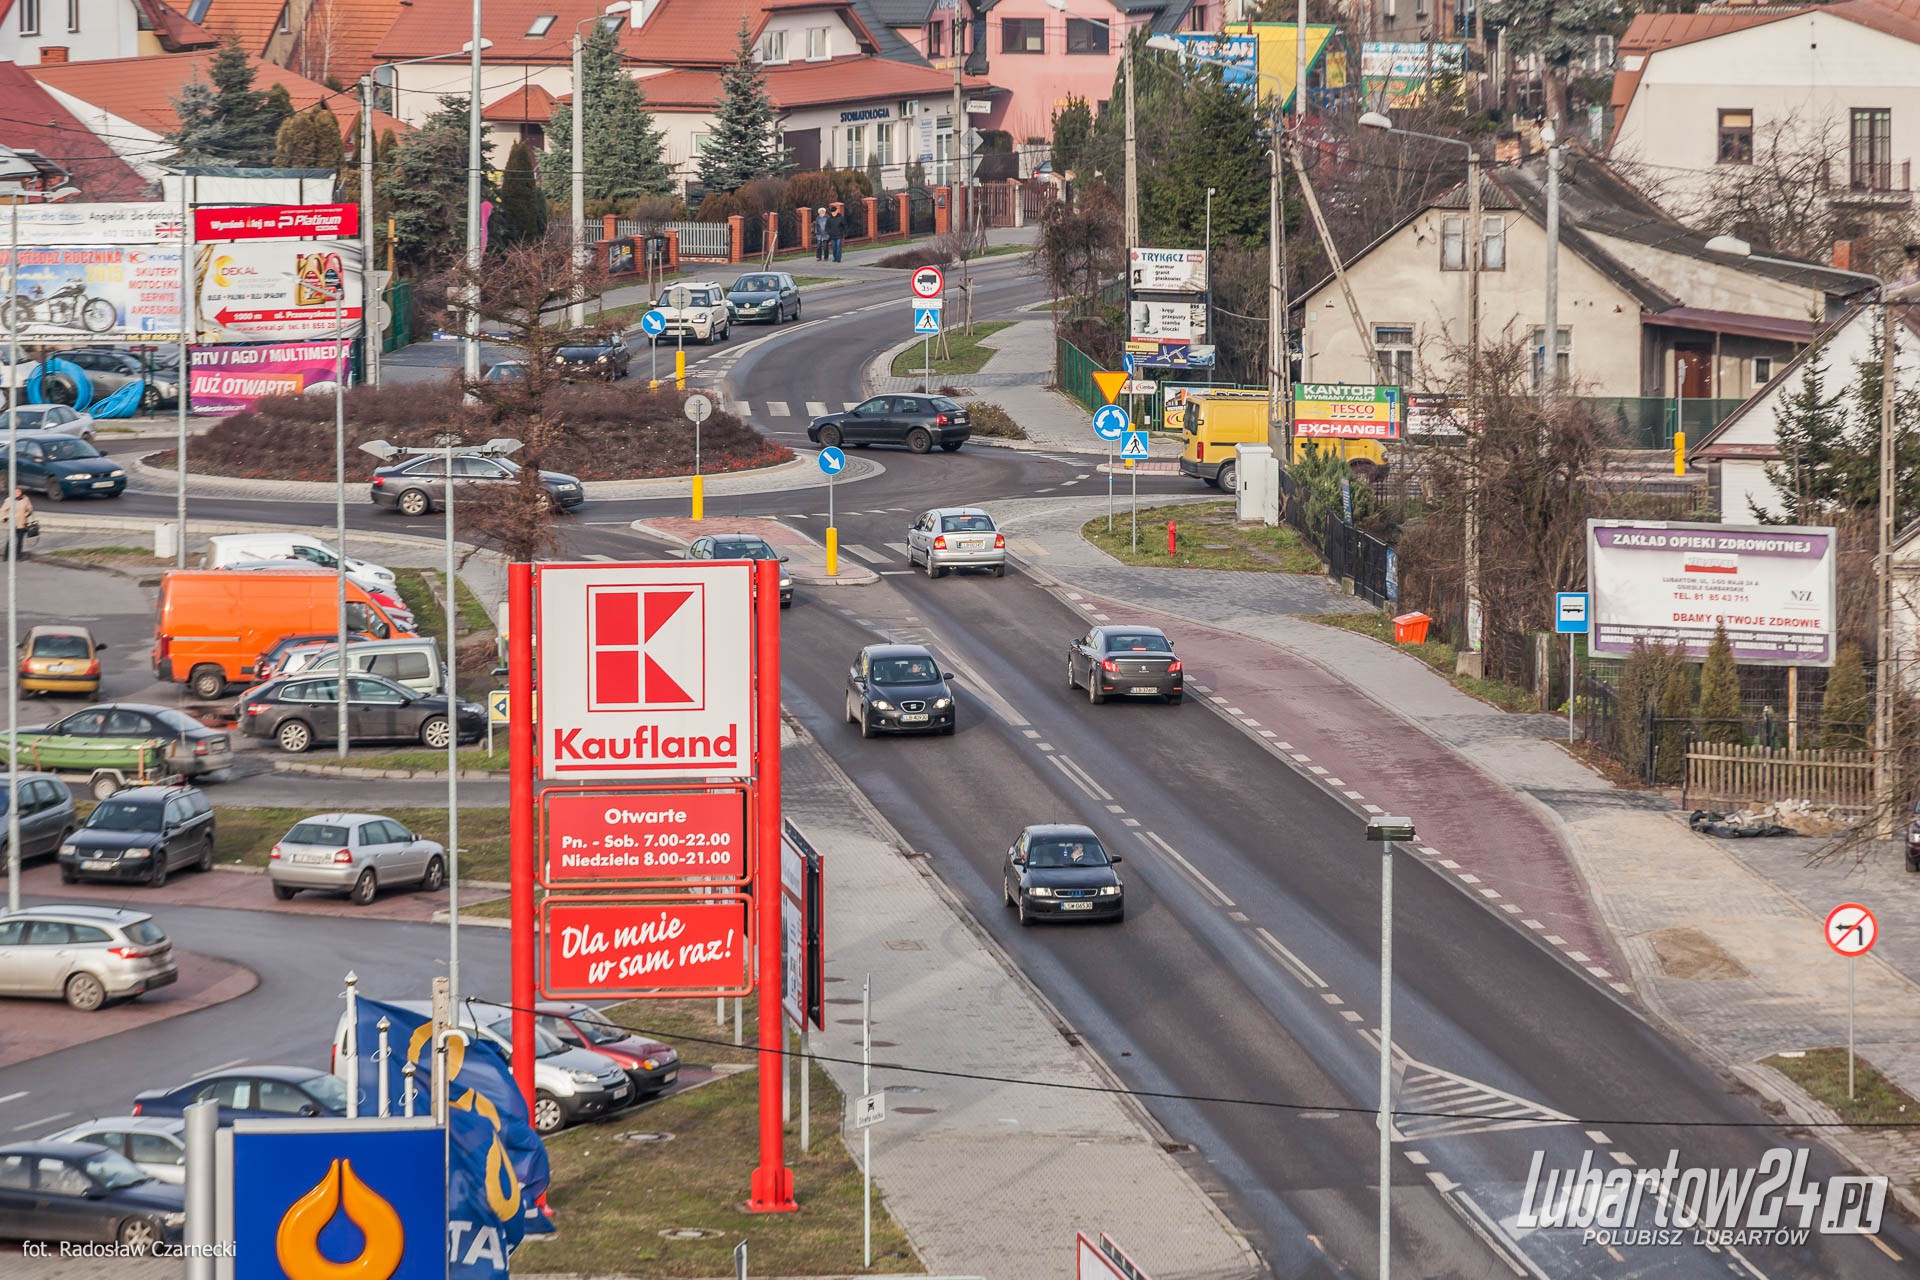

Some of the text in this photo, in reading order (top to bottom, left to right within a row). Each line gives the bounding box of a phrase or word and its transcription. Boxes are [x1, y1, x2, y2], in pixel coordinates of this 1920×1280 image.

[840, 108, 890, 123] STOMATOLOGIA
[294, 214, 342, 226] Platinum
[64, 251, 122, 265] ROCZNIKA
[1141, 252, 1184, 263] TRYKACZ
[86, 265, 125, 283] 2015
[136, 267, 179, 277] SKUTERY
[221, 266, 258, 276] DEKAL
[139, 292, 176, 302] SERWIS
[192, 345, 350, 366] RTV / AGD / MULTIMEDA
[193, 373, 221, 394] JUŻ
[1303, 385, 1376, 396] KANTOR
[1330, 404, 1375, 414] TESCO
[1297, 423, 1386, 437] EXCHANGE
[1612, 533, 1812, 553] ZAKŁAD OPIEKI ZDROWOTNEJ
[1673, 592, 1691, 600] TEL.
[1695, 593, 1704, 601] 81
[1721, 594, 1733, 602] 43
[1673, 613, 1711, 623] DBAMY
[1728, 615, 1766, 626] TWOJE
[1768, 617, 1821, 629] ZDROWIE
[554, 723, 737, 760] Kaufland
[604, 808, 687, 825] Otwarte
[561, 835, 587, 849] Pn.
[604, 834, 639, 848] Sob.
[644, 832, 731, 847] 7.00-22.00
[561, 851, 731, 867] Niedziela 8.00-21.00
[561, 911, 686, 958] Dla mnie
[588, 928, 734, 984] w sam raz!
